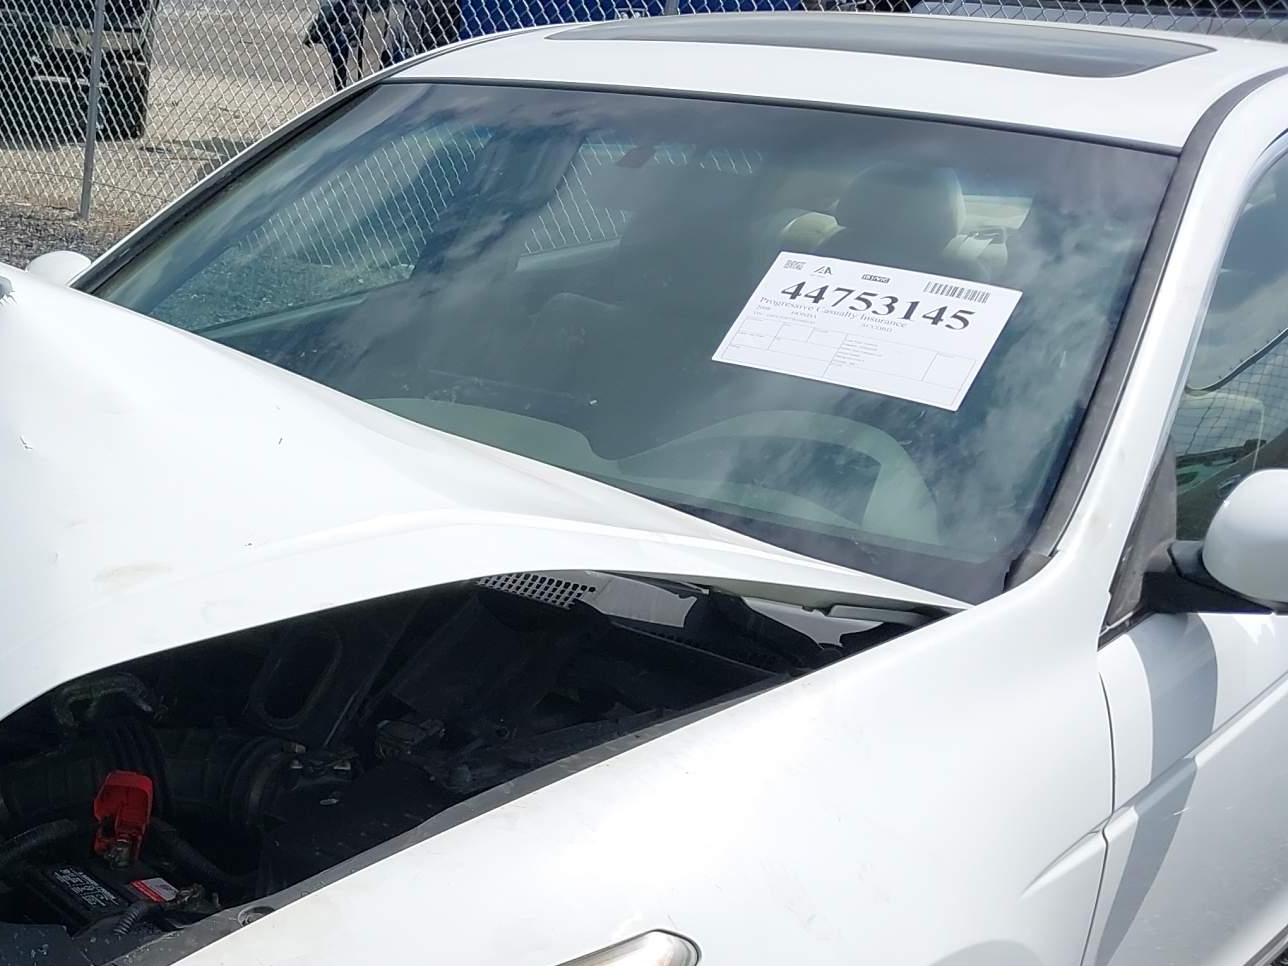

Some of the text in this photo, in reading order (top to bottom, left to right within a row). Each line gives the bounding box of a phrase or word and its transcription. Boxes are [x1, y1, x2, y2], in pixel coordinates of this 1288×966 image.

[759, 296, 815, 312] Progressive
[816, 304, 857, 320] Casualty
[859, 312, 907, 329] Insurance
[780, 280, 976, 331] 44753145
